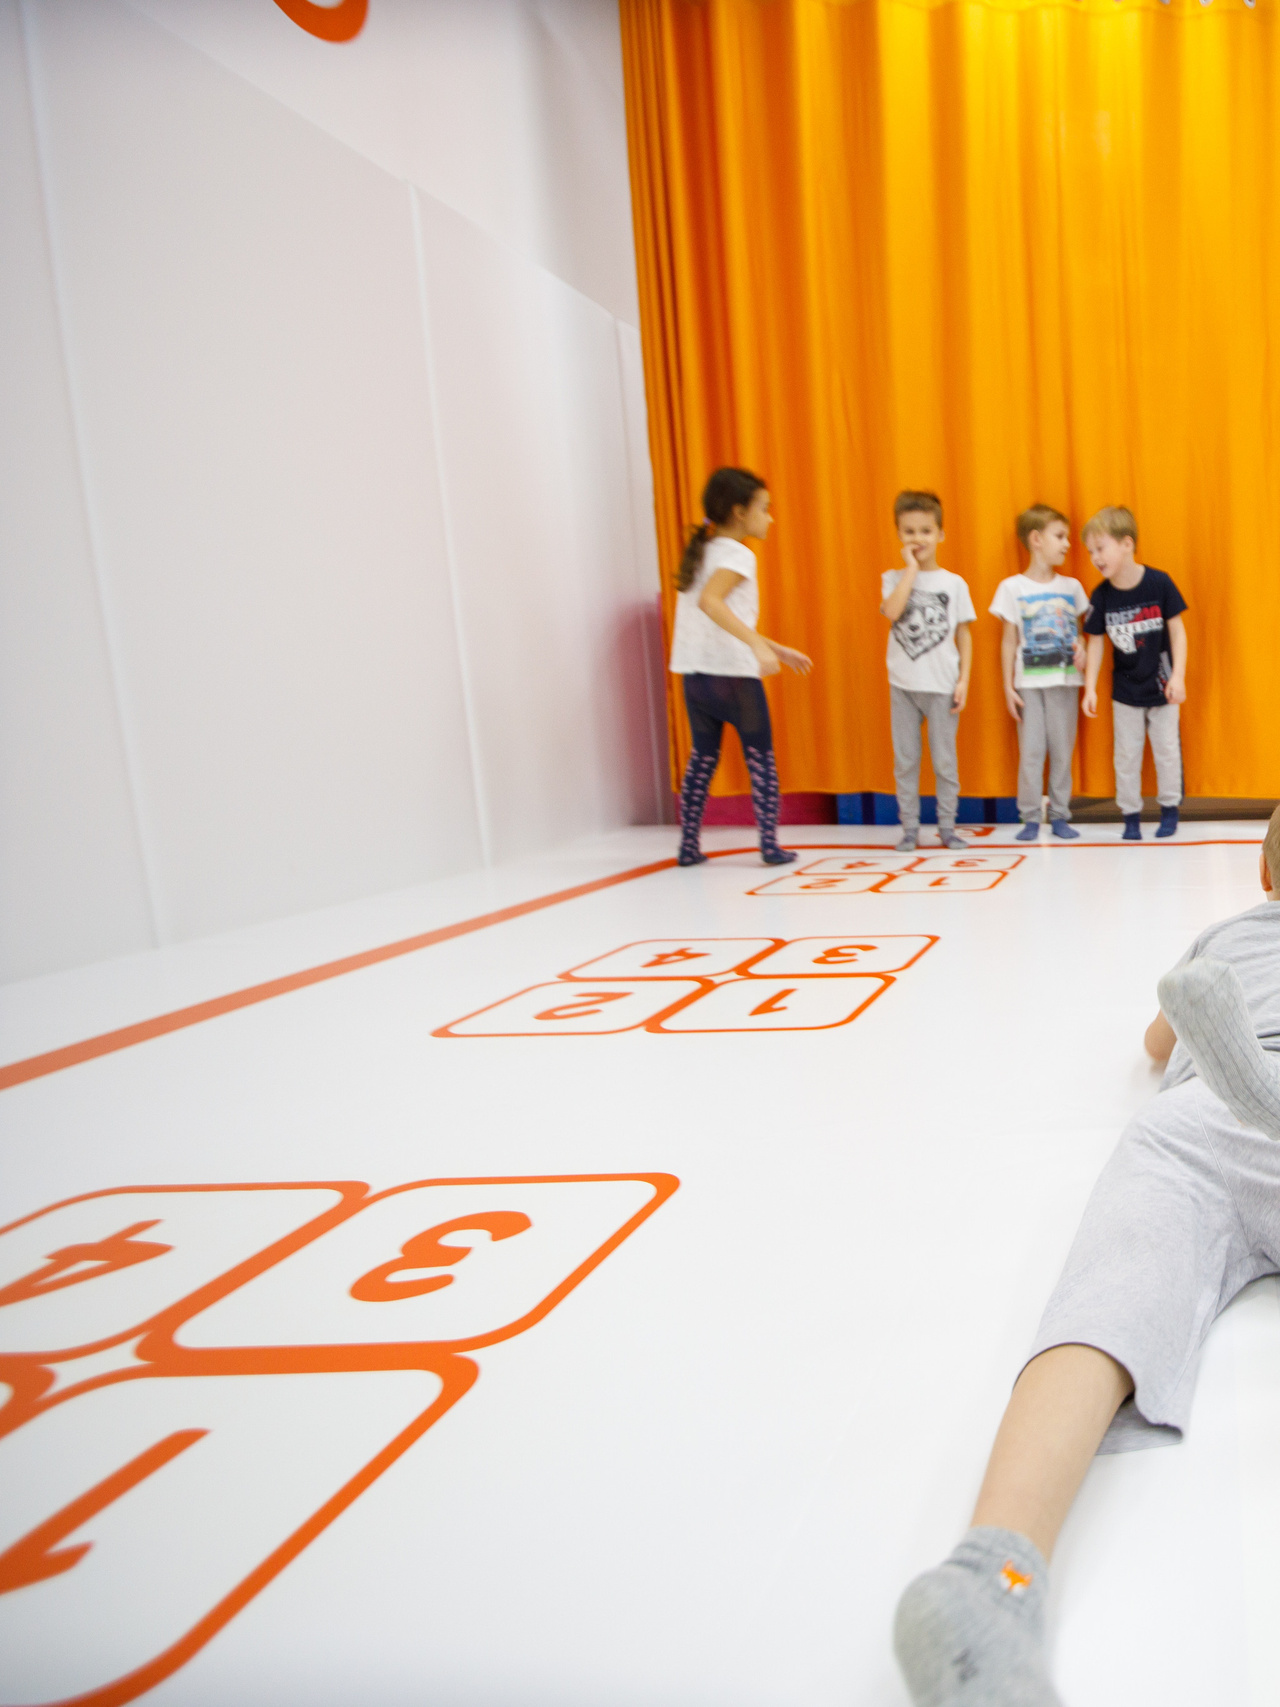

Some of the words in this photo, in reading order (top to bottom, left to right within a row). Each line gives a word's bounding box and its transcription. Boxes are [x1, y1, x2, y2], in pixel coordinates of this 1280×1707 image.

[798, 878, 848, 890] 2
[641, 947, 710, 968] 4
[812, 943, 879, 965] 3
[534, 992, 633, 1021] 2
[748, 987, 798, 1017] 1
[348, 1210, 533, 1303] 3
